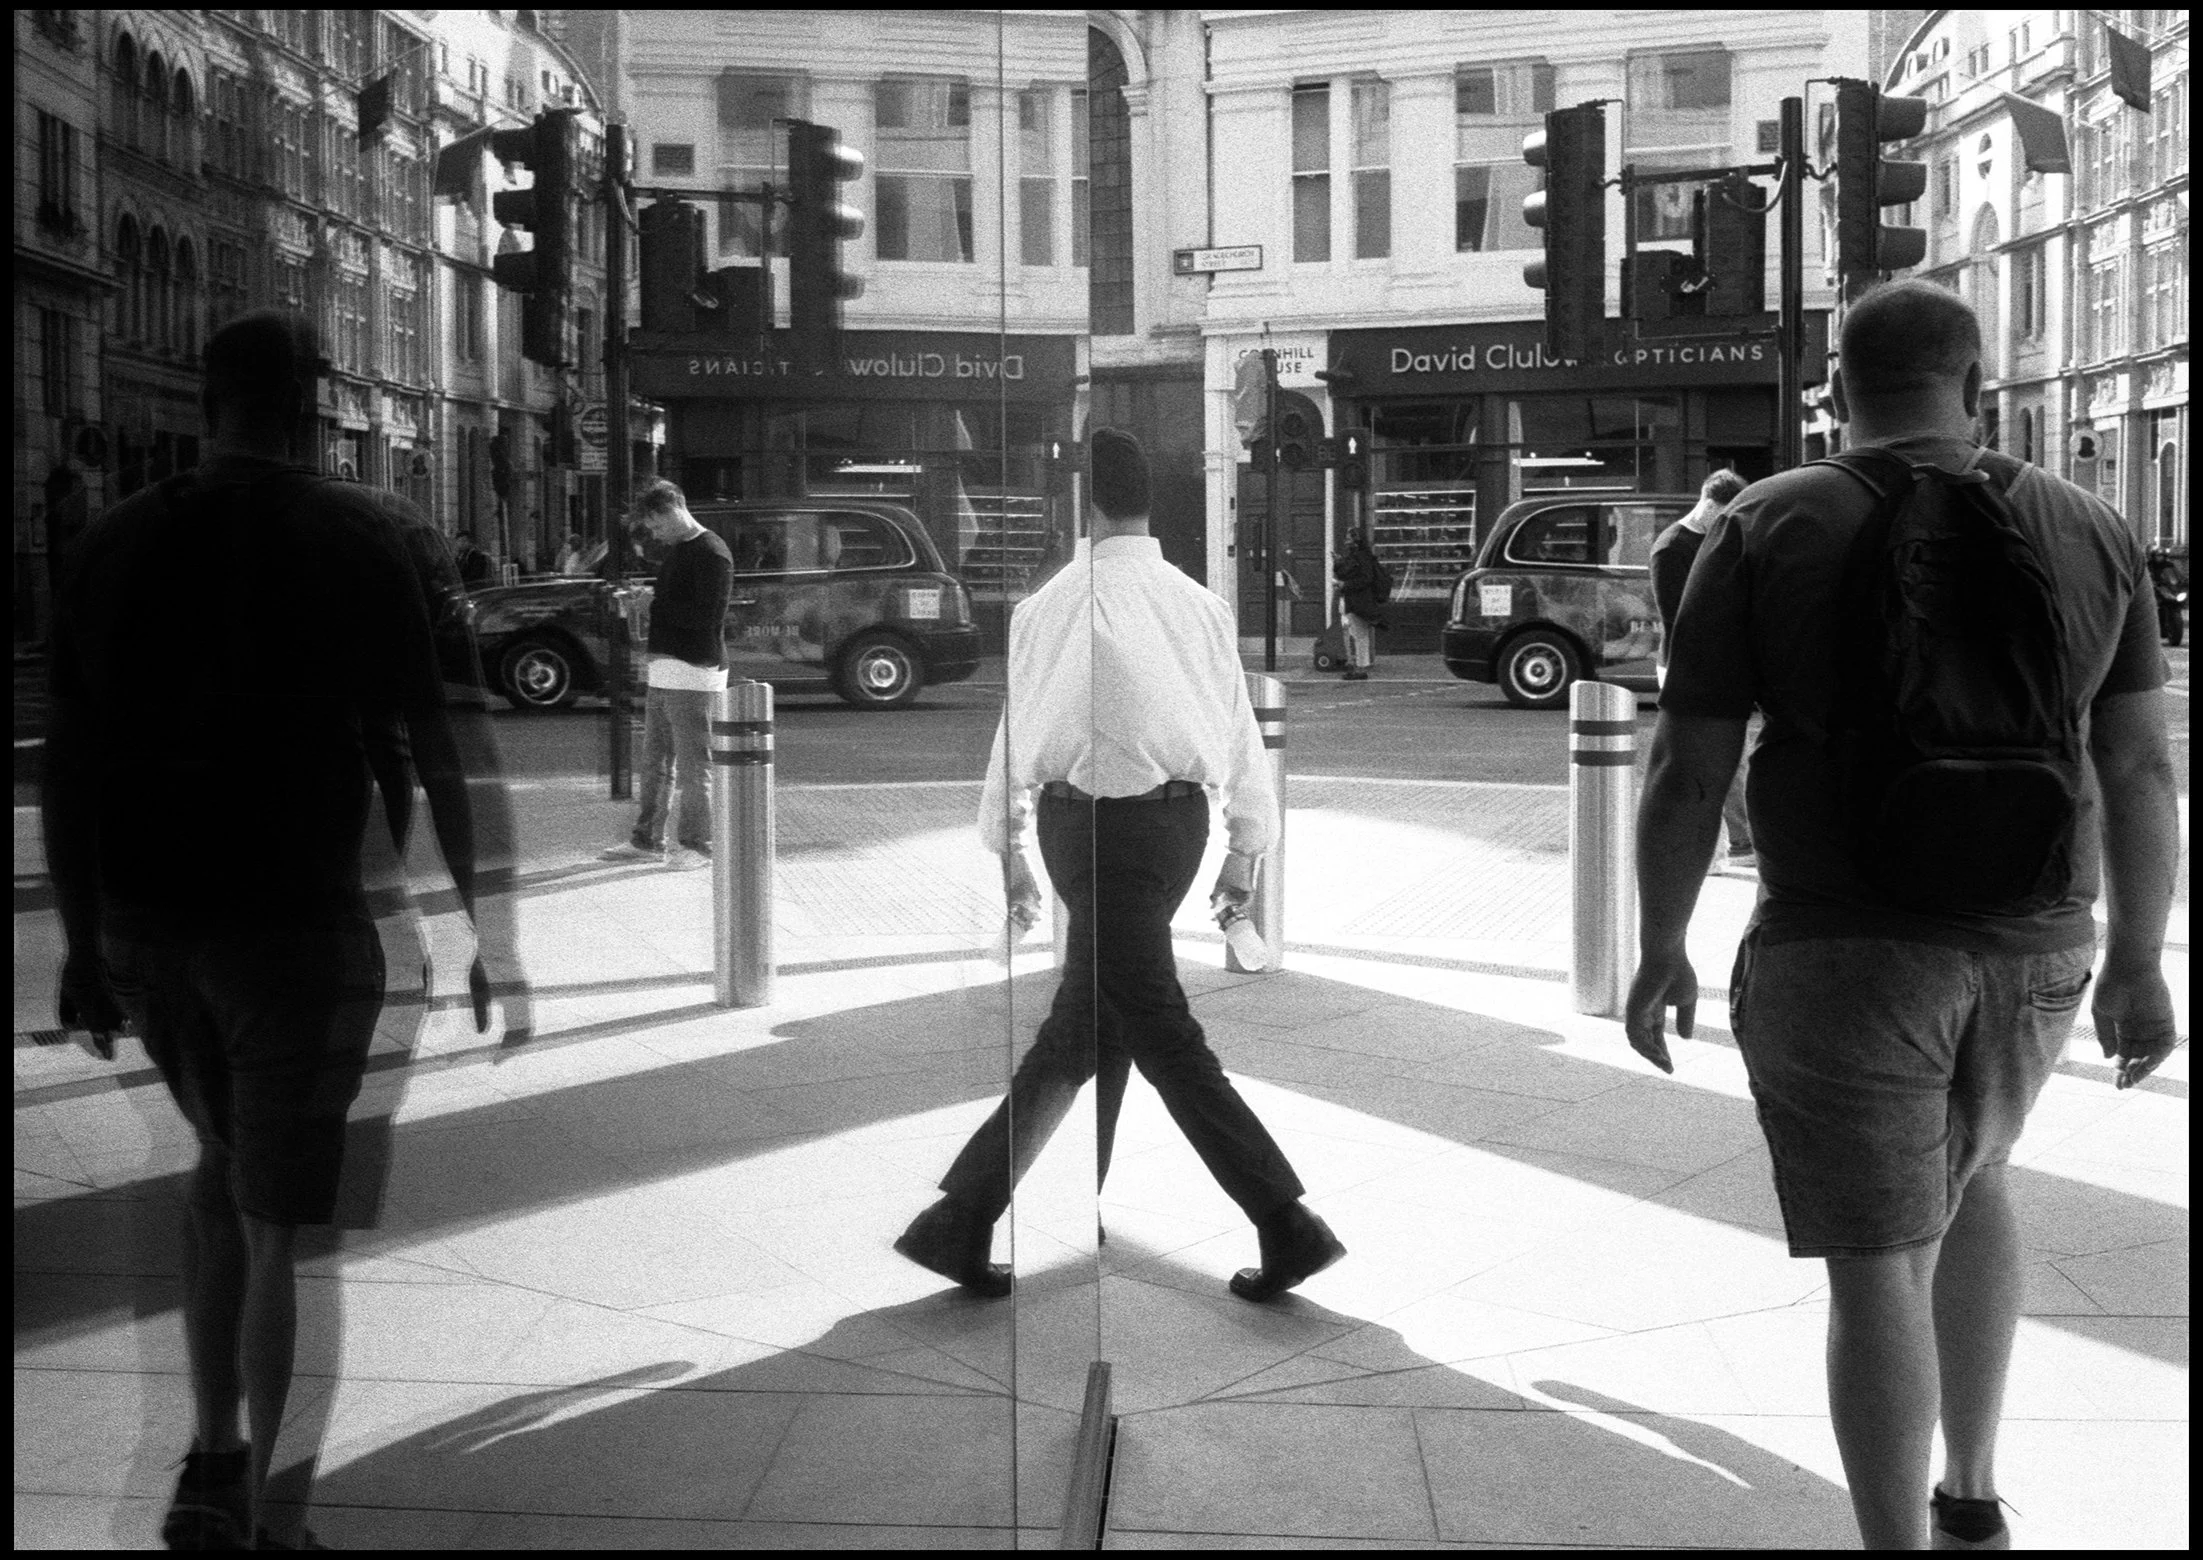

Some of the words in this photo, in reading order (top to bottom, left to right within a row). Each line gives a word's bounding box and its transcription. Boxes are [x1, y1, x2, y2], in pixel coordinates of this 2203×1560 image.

[1238, 347, 1314, 361] CNHILL
[1391, 346, 1476, 373] David
[1485, 342, 1578, 370] Clulo
